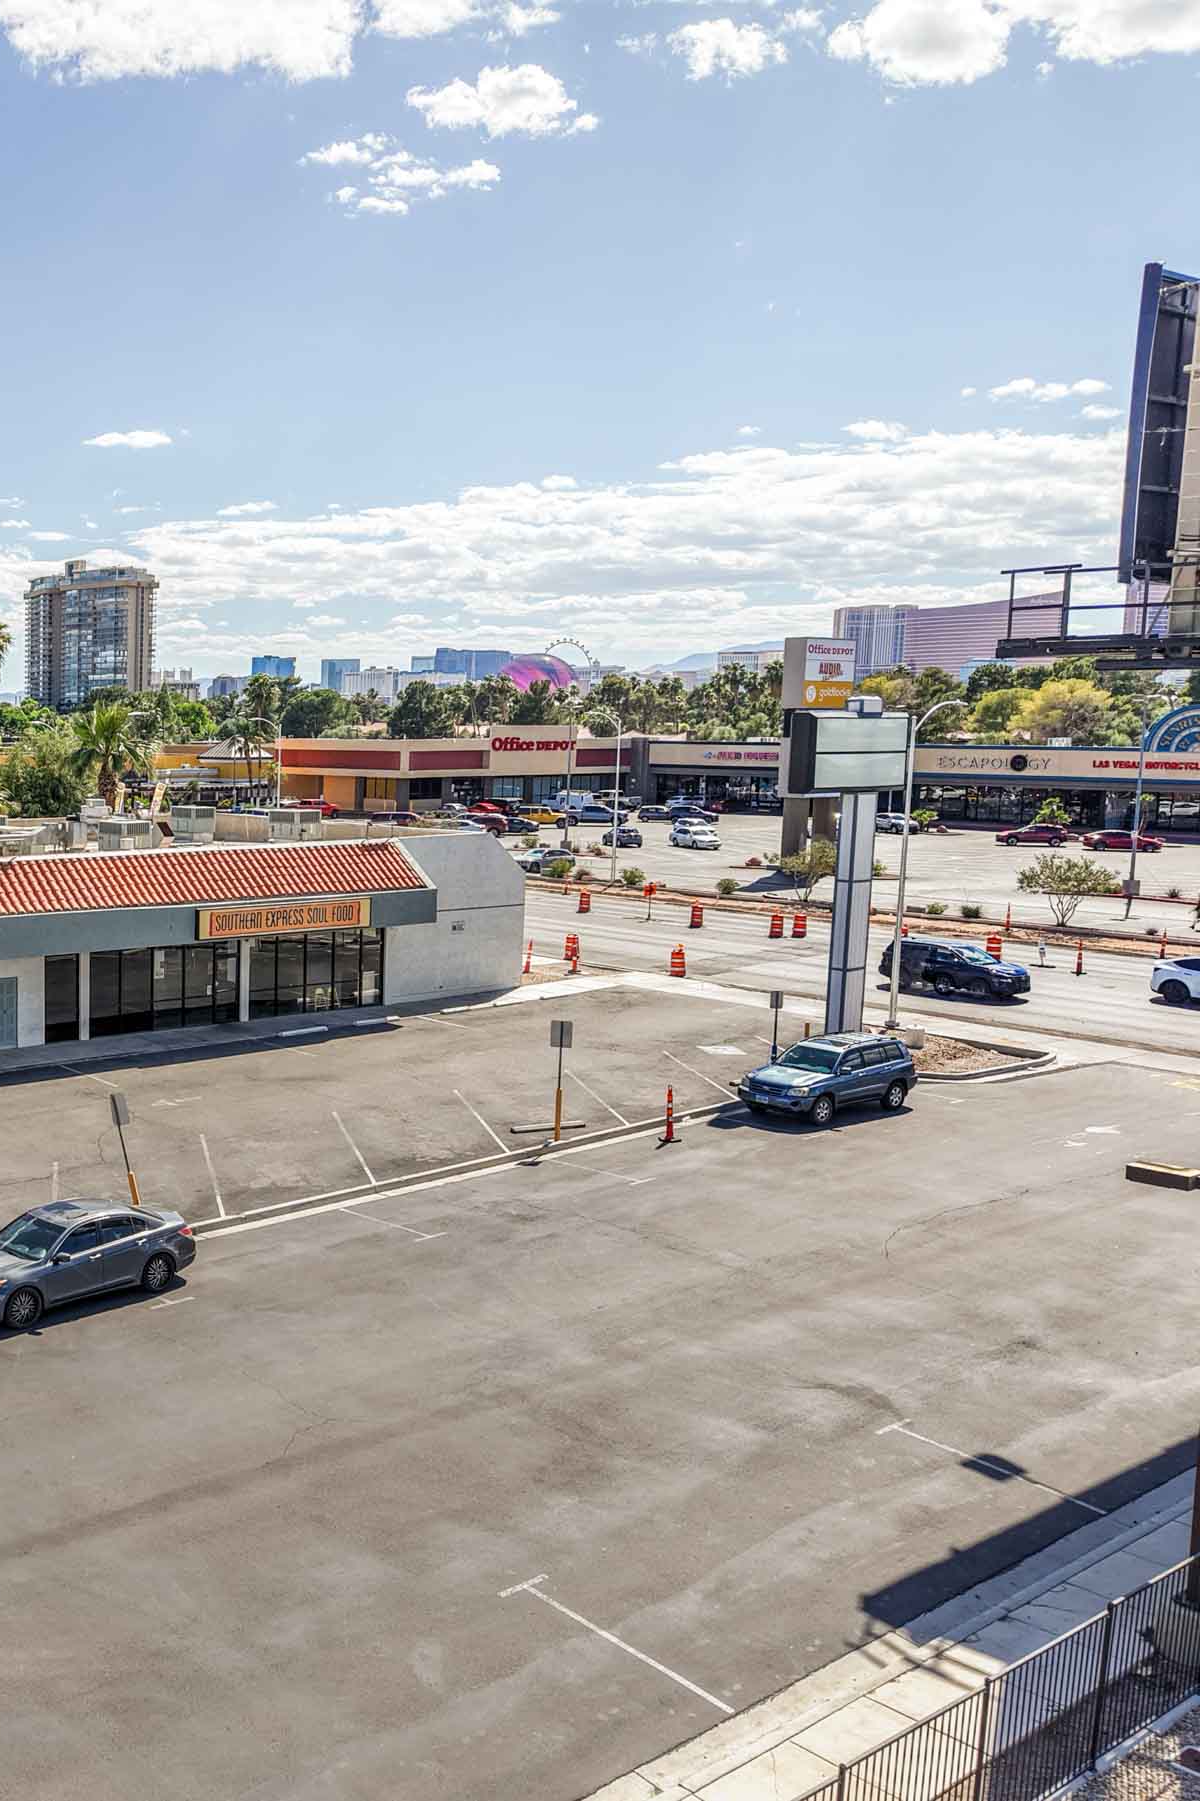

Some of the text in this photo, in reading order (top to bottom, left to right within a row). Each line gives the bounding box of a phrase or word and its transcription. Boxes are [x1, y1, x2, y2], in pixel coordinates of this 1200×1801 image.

[808, 644, 831, 654] Office
[491, 737, 577, 751] Office DEPOT
[936, 753, 1052, 772] ESCAPOLOGY
[1092, 759, 1110, 769] LAS
[216, 904, 354, 931] SOUTHERN EXPRESS SOUL FOOD
